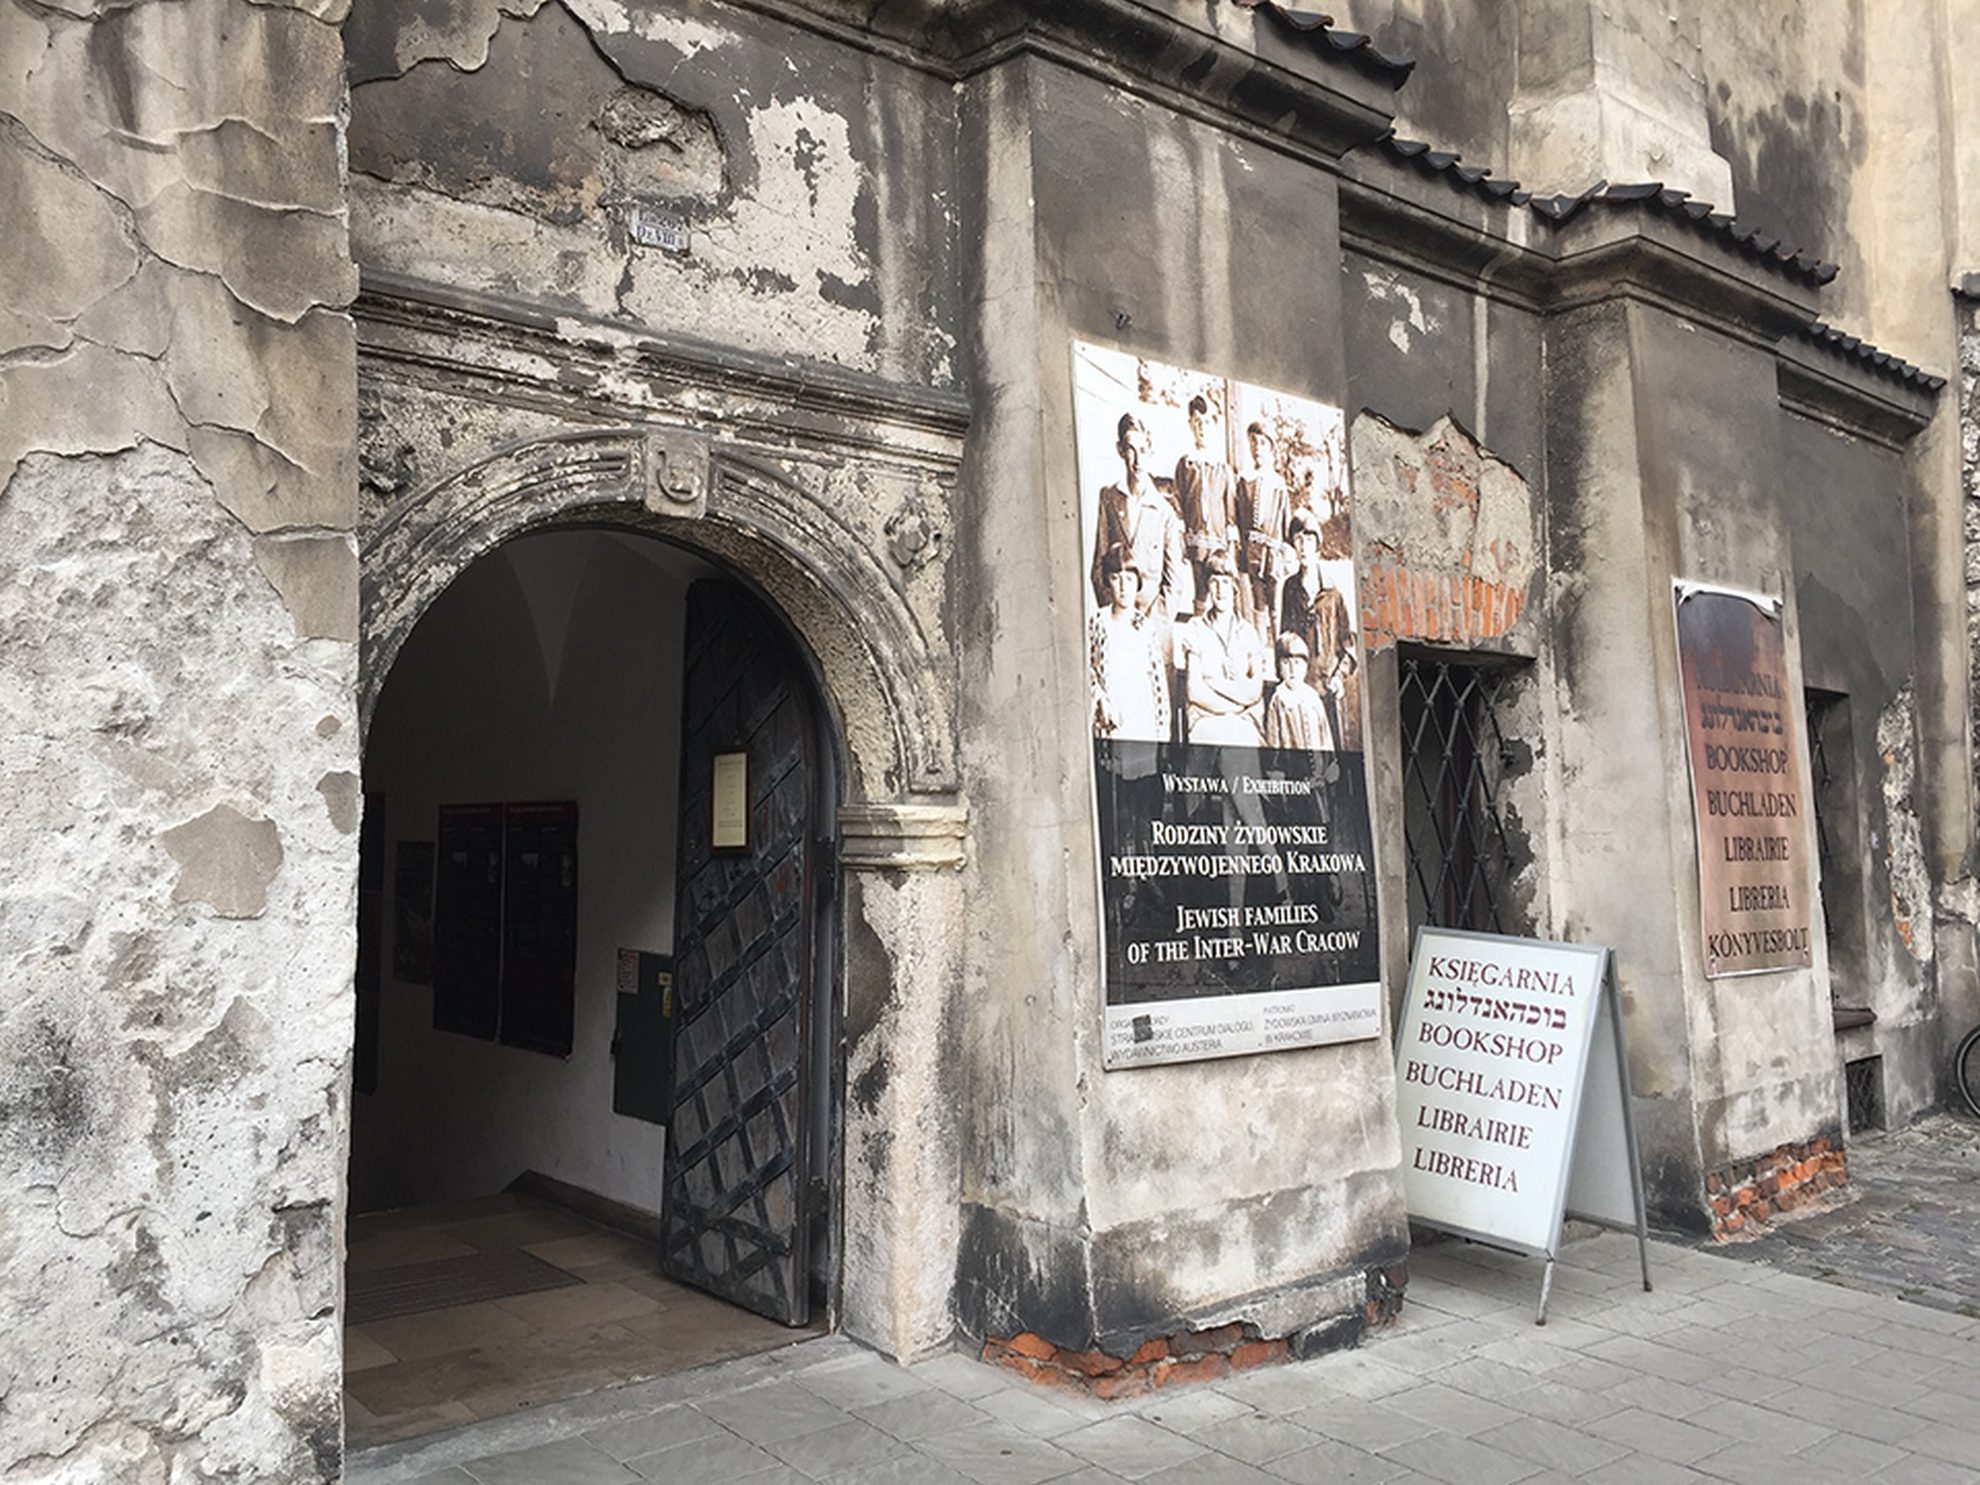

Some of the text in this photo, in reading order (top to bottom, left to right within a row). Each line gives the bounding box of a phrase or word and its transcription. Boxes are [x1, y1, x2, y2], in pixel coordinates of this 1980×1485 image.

[1705, 743, 1788, 774] BOOKSHOP
[1707, 789, 1797, 818] BUCHLADEN
[1151, 820, 1228, 845] RODZINY
[1287, 851, 1366, 873] KRAKOWA
[1724, 836, 1790, 862] LIBRAIRIE
[1729, 885, 1790, 912] LIBRERIA
[1176, 904, 1318, 933] JEWISH FAMILIES
[1127, 943, 1150, 964] OF
[1155, 940, 1189, 962] THE
[1296, 930, 1361, 953] CRACOW
[1428, 956, 1576, 997] KSIĘGARNIA
[1419, 1022, 1563, 1065] BOOKSHOP
[1406, 1060, 1562, 1110] BUCHLADEN
[1417, 1105, 1534, 1150] LIBRAIRIE
[1413, 1148, 1519, 1192] LIBRERIA
